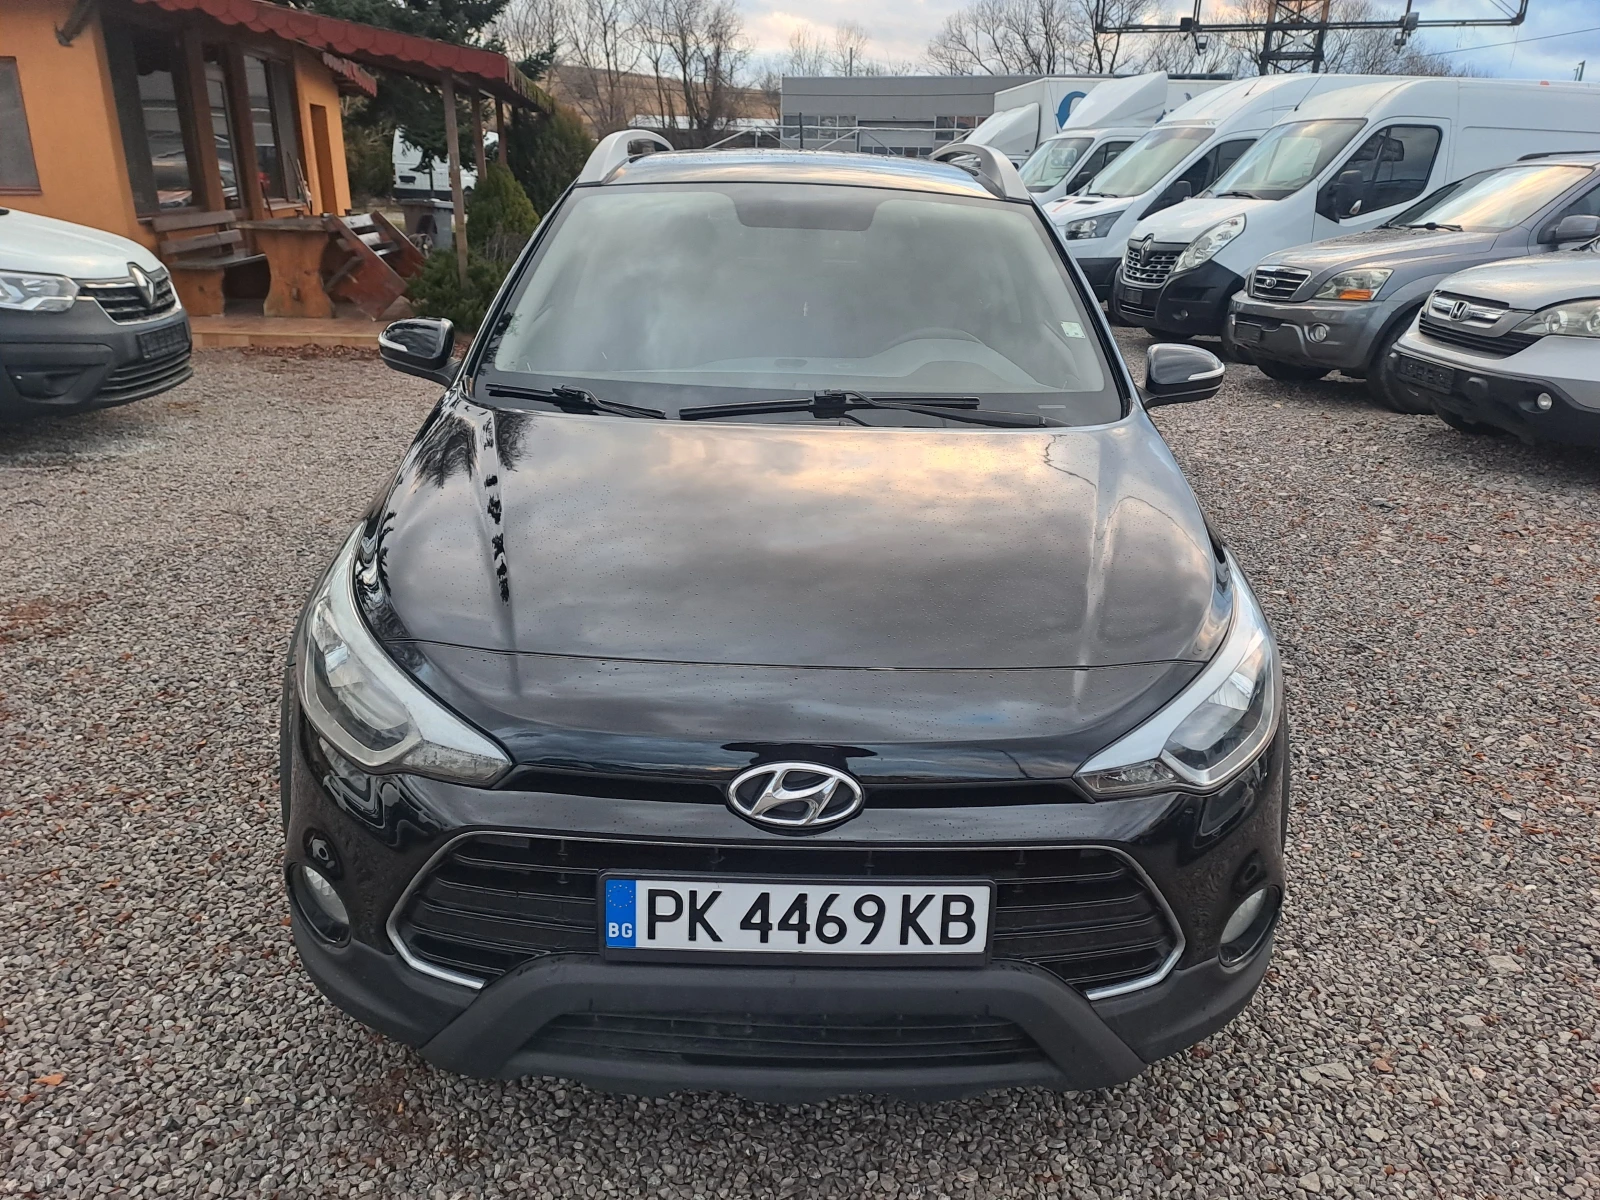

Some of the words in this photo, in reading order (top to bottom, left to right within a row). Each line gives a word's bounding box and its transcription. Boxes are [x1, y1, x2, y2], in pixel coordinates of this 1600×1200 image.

[608, 922, 633, 938] BG
[647, 889, 722, 942] PK
[739, 892, 887, 945] 4469
[899, 894, 977, 946] KB
